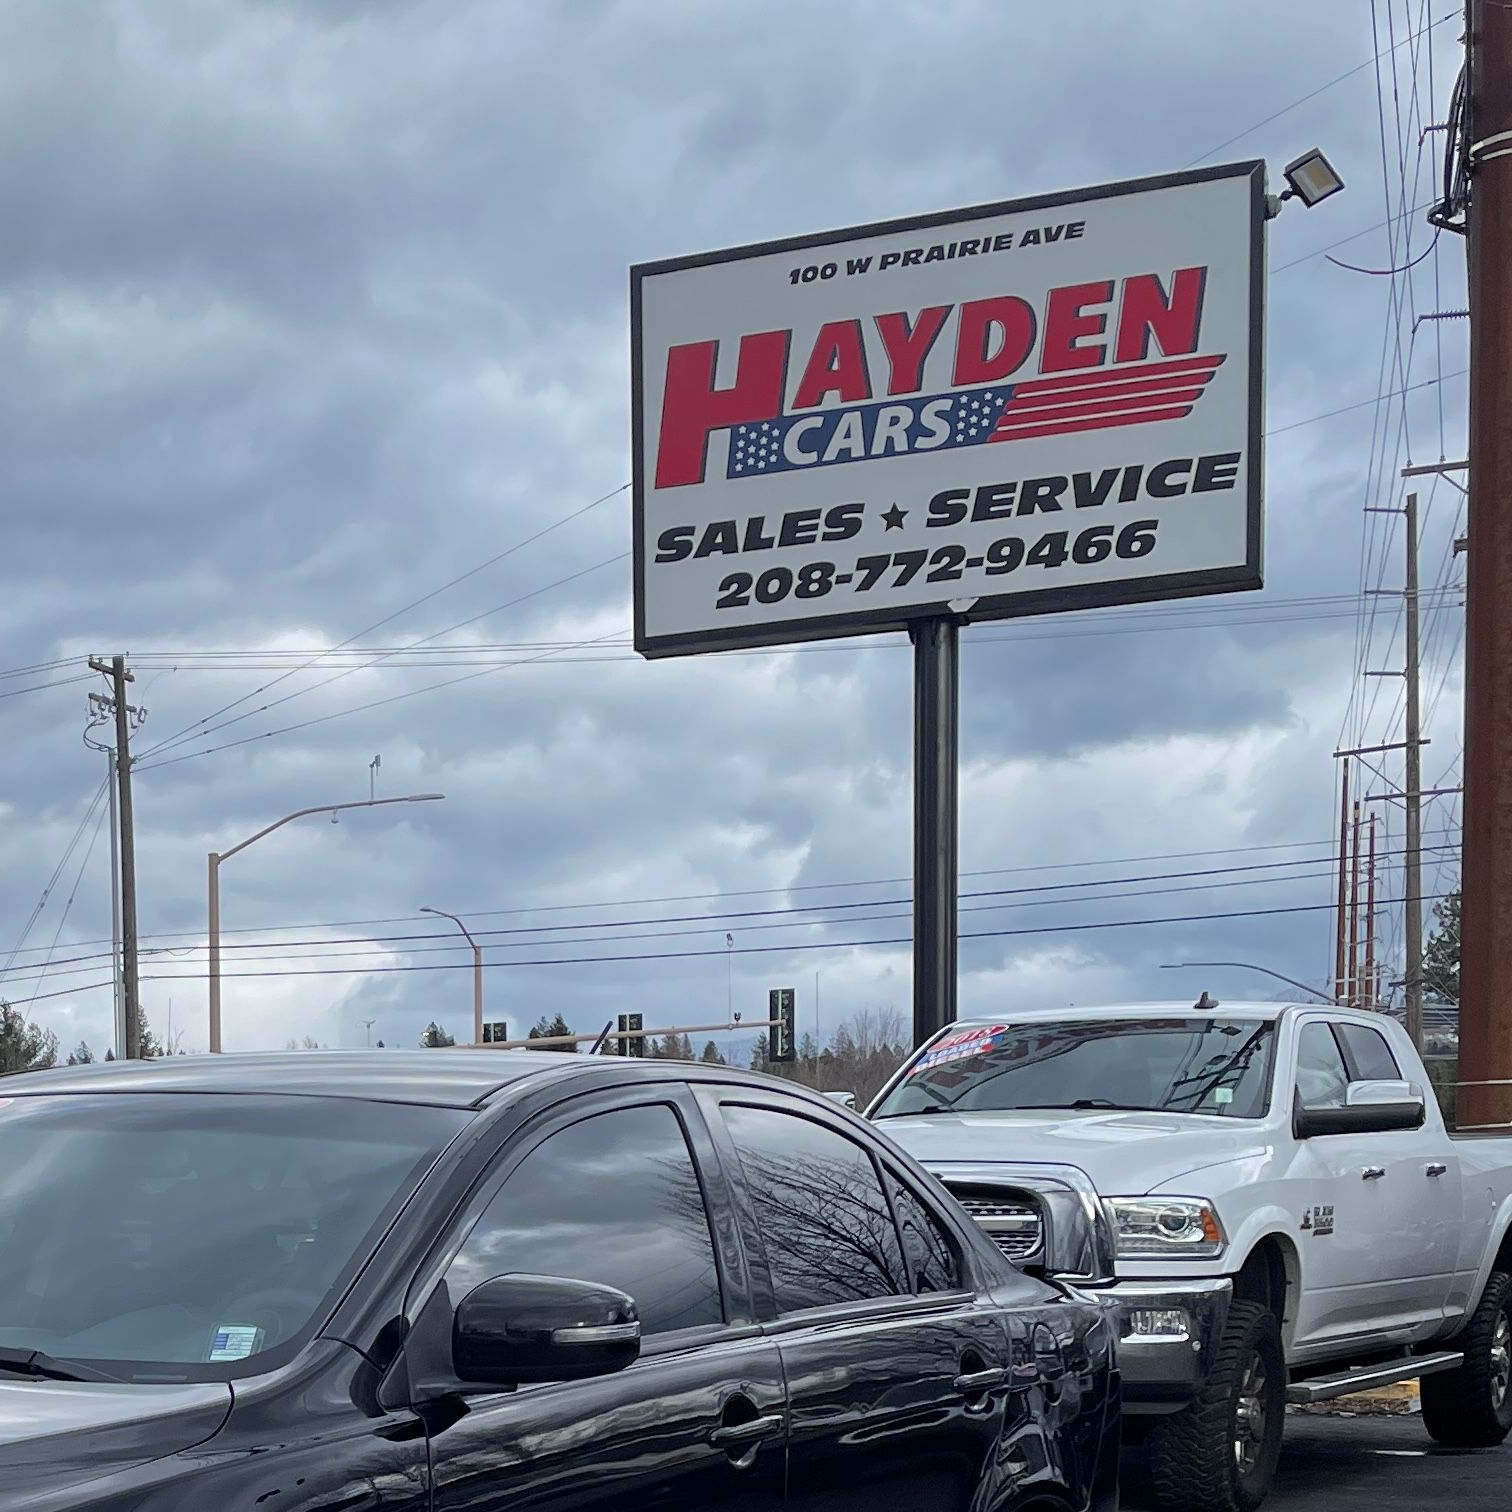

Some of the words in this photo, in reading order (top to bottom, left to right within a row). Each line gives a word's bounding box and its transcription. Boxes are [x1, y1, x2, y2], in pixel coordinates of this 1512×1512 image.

[788, 262, 837, 285] 100
[844, 256, 873, 276] W
[879, 233, 1014, 270] PRAIRIE
[1018, 221, 1087, 248] AVE
[654, 266, 1208, 490] HAYDEN
[782, 397, 955, 466] CARS
[655, 503, 866, 563] SALES
[925, 452, 1242, 528] SERVICE
[715, 520, 1159, 610] 208-772-9466
